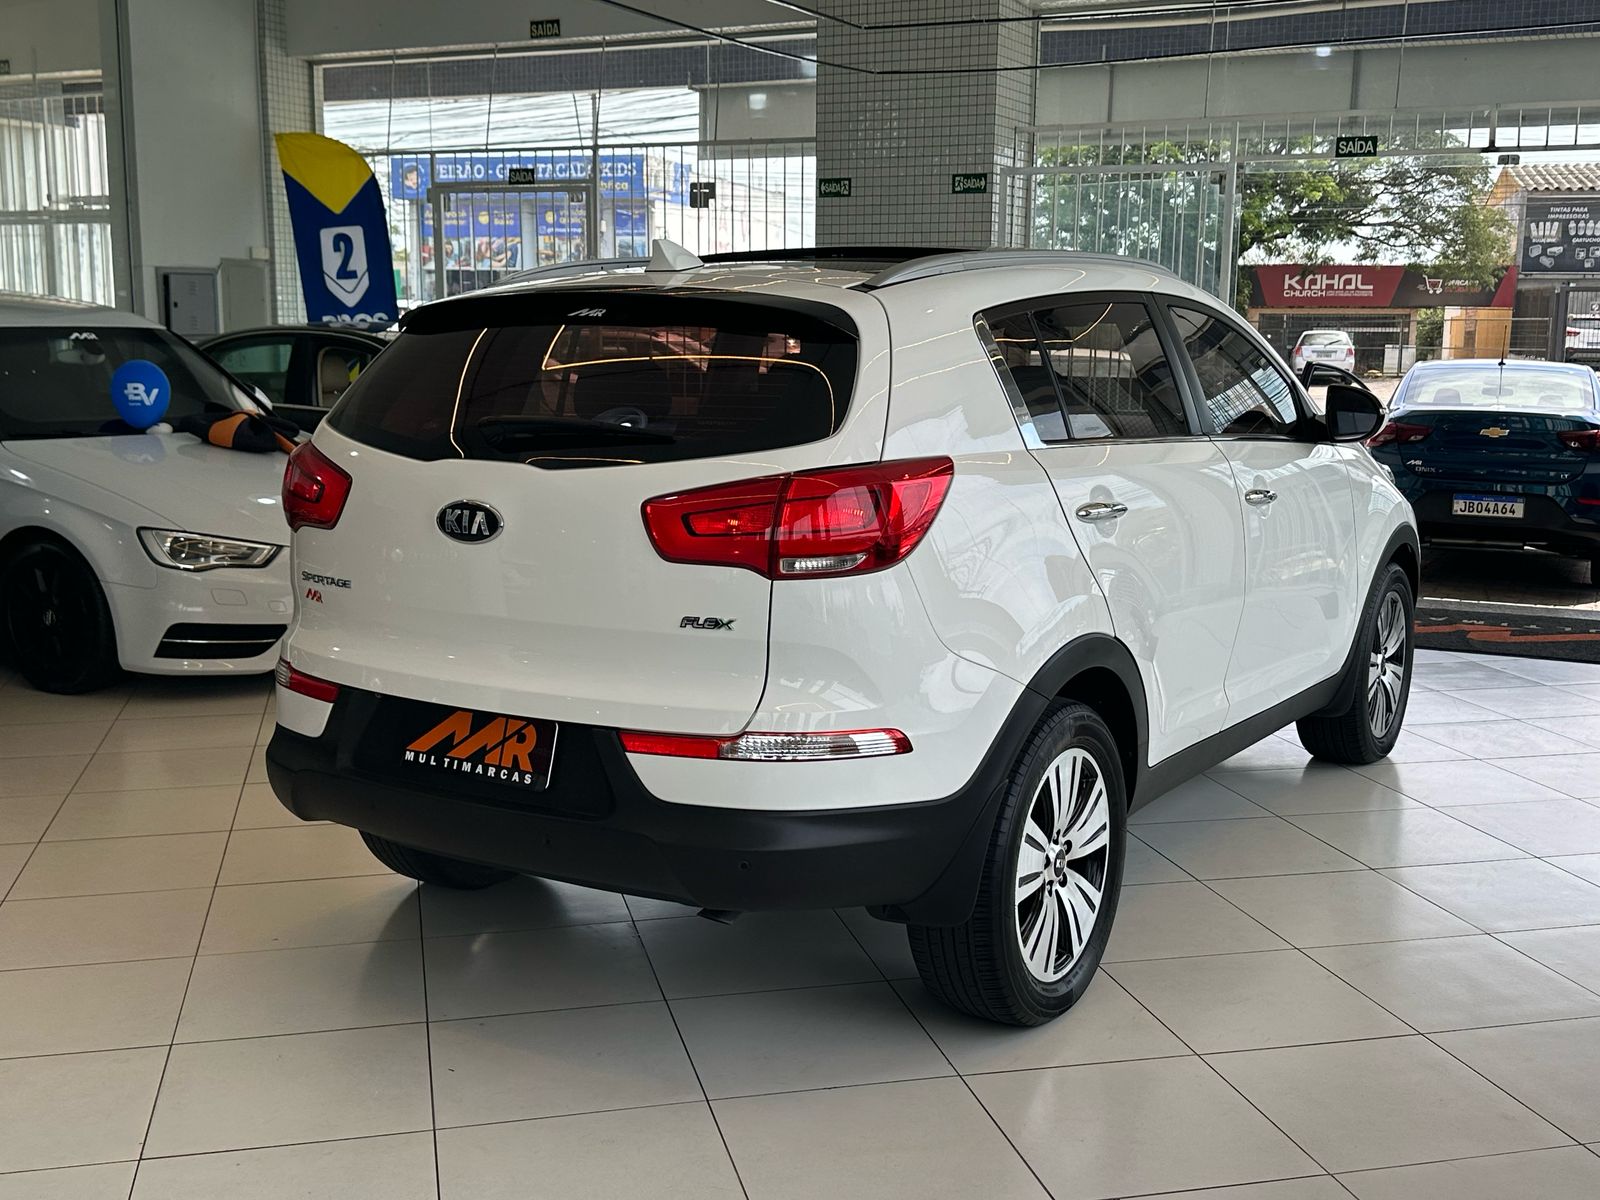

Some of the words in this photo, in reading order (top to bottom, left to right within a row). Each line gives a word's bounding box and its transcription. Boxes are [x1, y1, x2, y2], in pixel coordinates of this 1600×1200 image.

[531, 21, 560, 37] SAÍDA
[1338, 137, 1375, 154] SAÍDA
[510, 169, 534, 183] SAÍDA
[963, 176, 981, 189] SAÍDA
[824, 180, 841, 193] SAÍDA
[332, 232, 358, 281] 2
[1283, 273, 1374, 290] KAHAL
[1283, 289, 1326, 297] CHURCH
[124, 382, 160, 407] BV
[444, 508, 490, 536] KIA
[301, 570, 352, 589] SPORTAGE
[679, 615, 736, 631] FLEX
[404, 750, 533, 785] MULTIMARCAS
